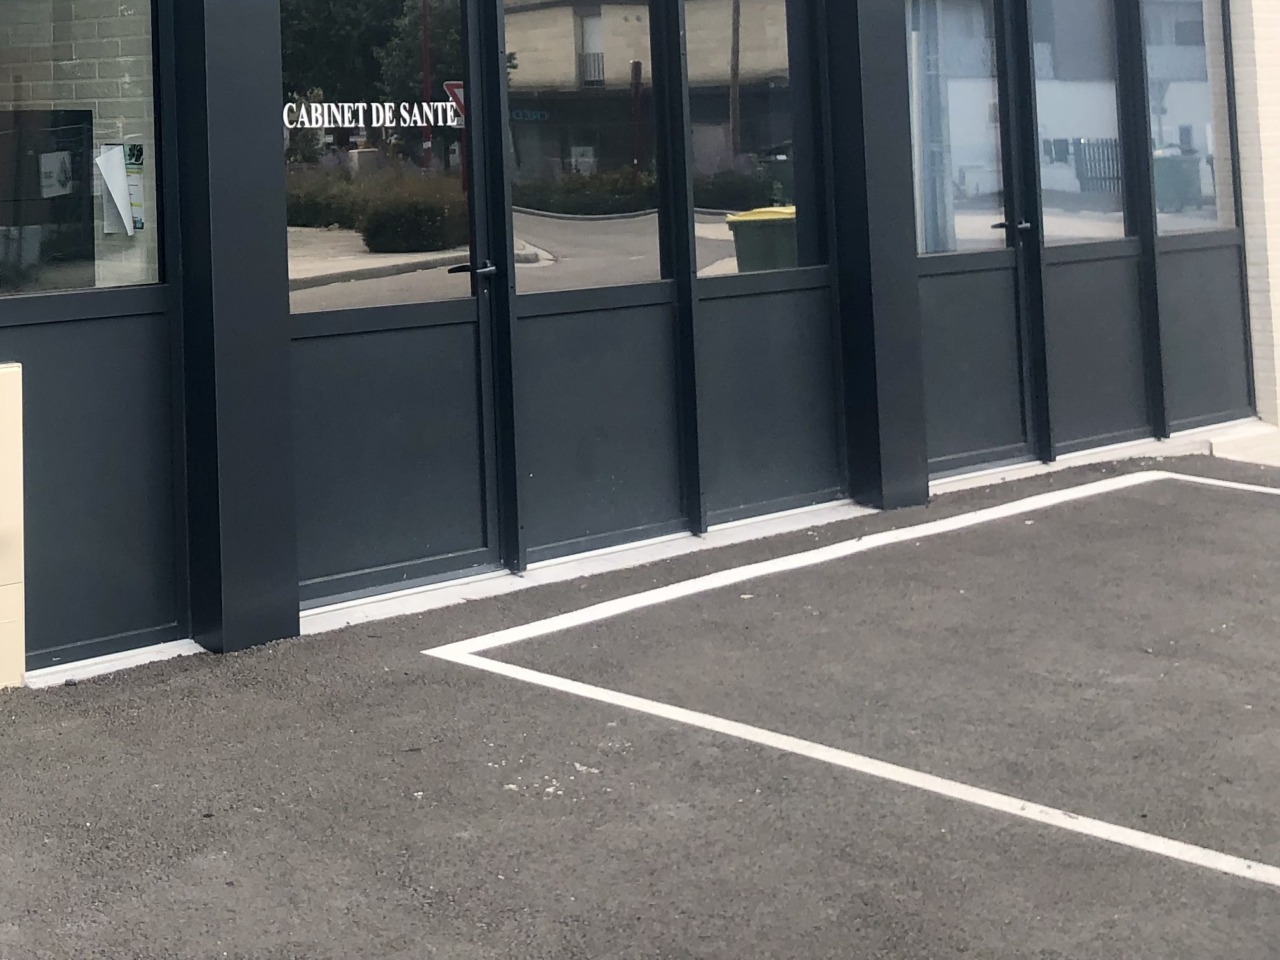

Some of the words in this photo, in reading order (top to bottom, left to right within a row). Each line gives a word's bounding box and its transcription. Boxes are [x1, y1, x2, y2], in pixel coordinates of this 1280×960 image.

[283, 102, 367, 129] CABINET
[371, 102, 395, 128] DE
[400, 97, 458, 127] SANTÉ
